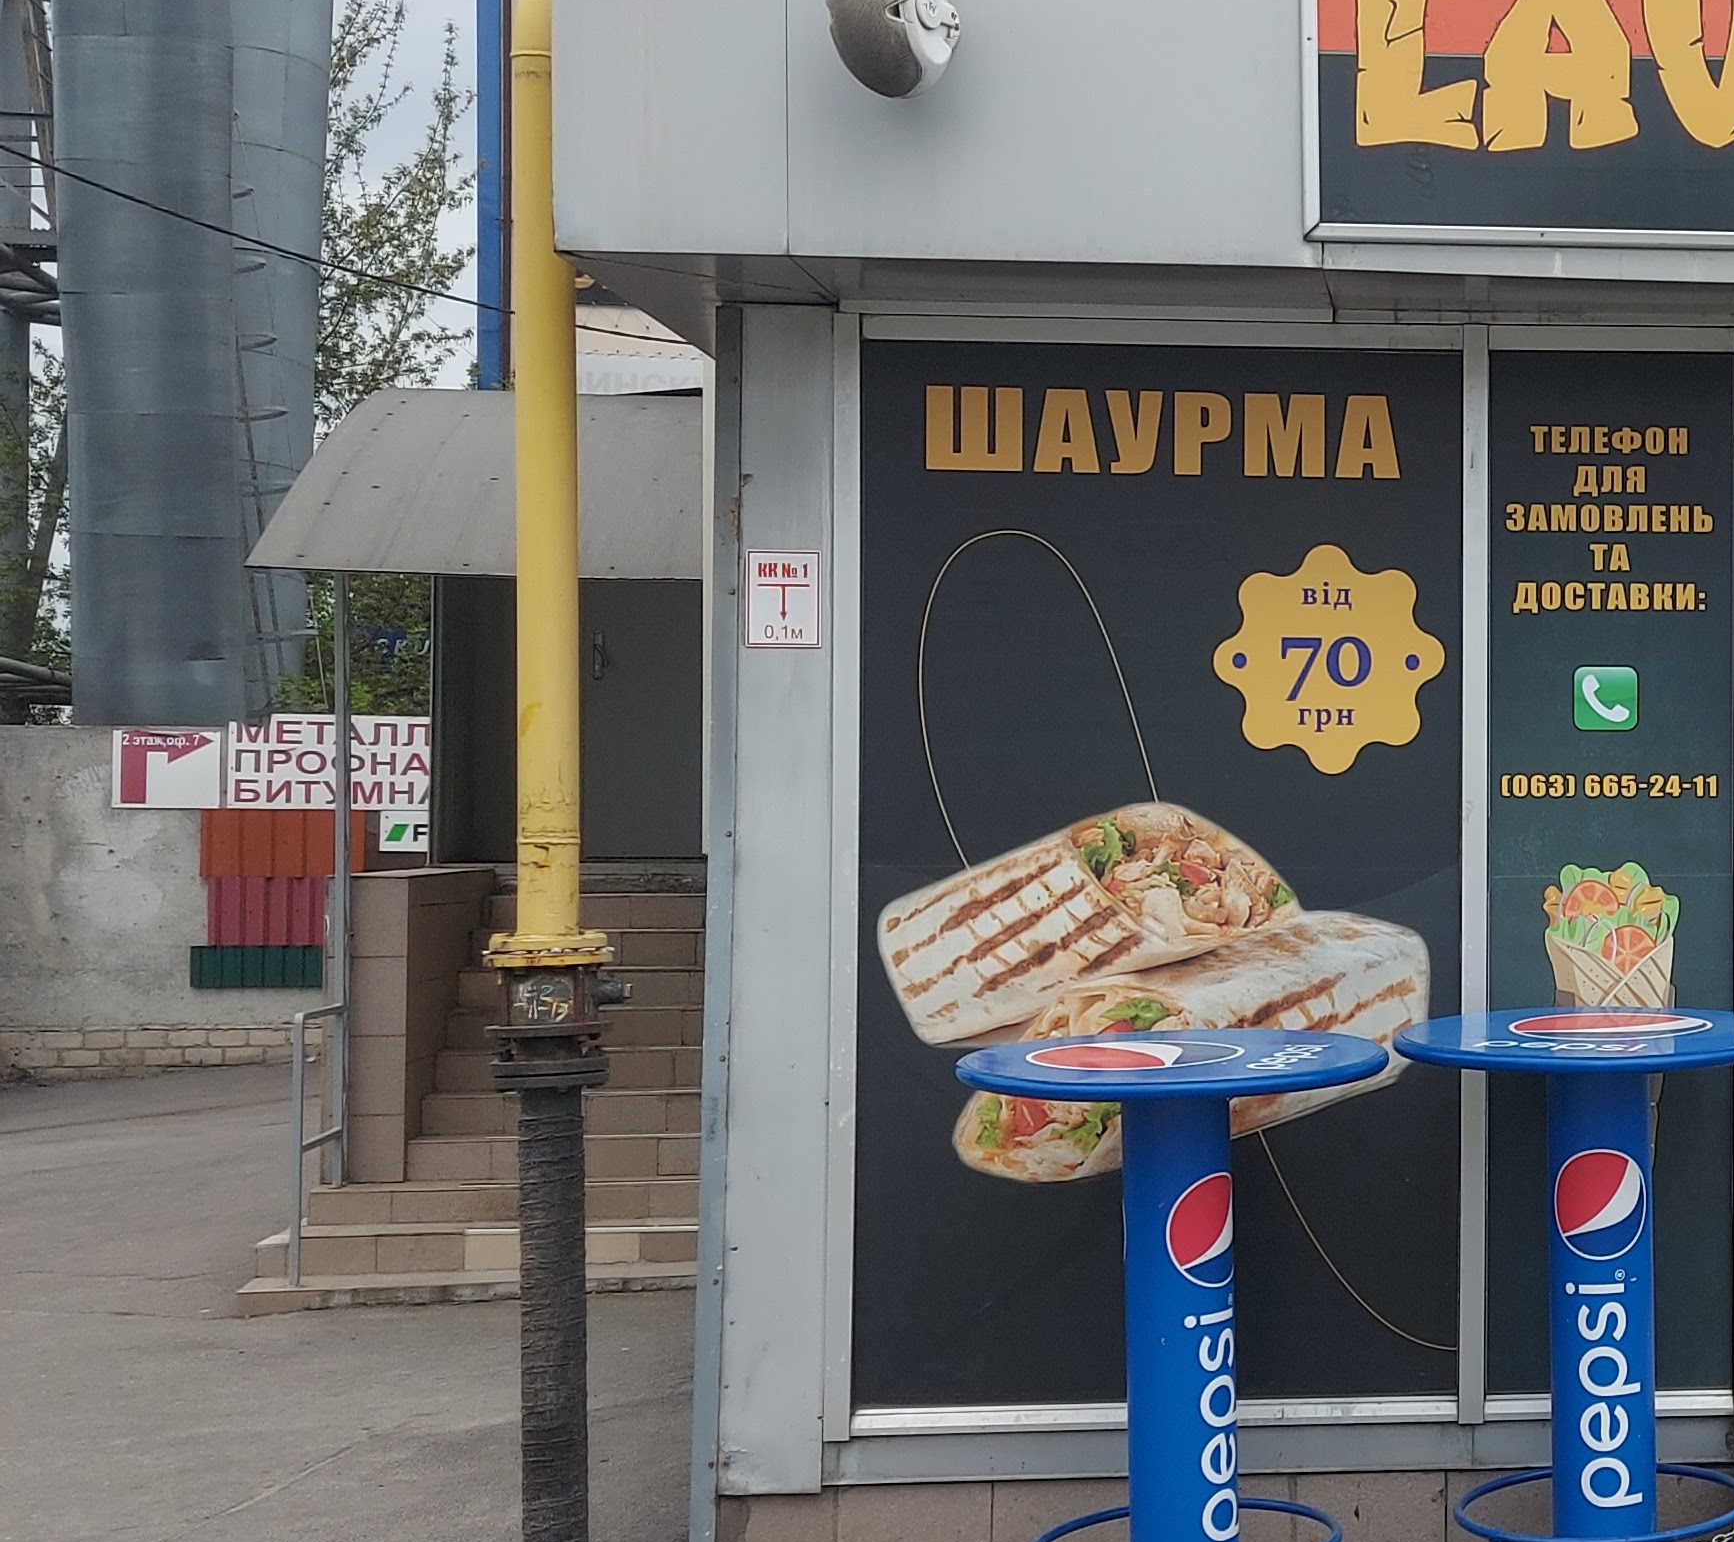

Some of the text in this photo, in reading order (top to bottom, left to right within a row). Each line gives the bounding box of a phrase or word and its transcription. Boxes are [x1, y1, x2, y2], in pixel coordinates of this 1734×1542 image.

[925, 385, 1401, 479] ШАУРМА
[1530, 425, 1688, 455] ТЕЛЕФОН
[1573, 465, 1646, 497] ДЛЯ
[1505, 503, 1715, 533] ЗАМОВЛЕНЬ
[1589, 543, 1631, 571] ТА
[1301, 581, 1353, 611] від
[1512, 581, 1706, 614] ДОСТАВКИ:
[1281, 635, 1372, 702] 70
[1298, 707, 1355, 733] грн
[122, 734, 130, 746] 2
[1501, 773, 1719, 798] (063) 665-24-11
[1246, 1043, 1332, 1070] pepsi
[1565, 1281, 1644, 1509] pepsi
